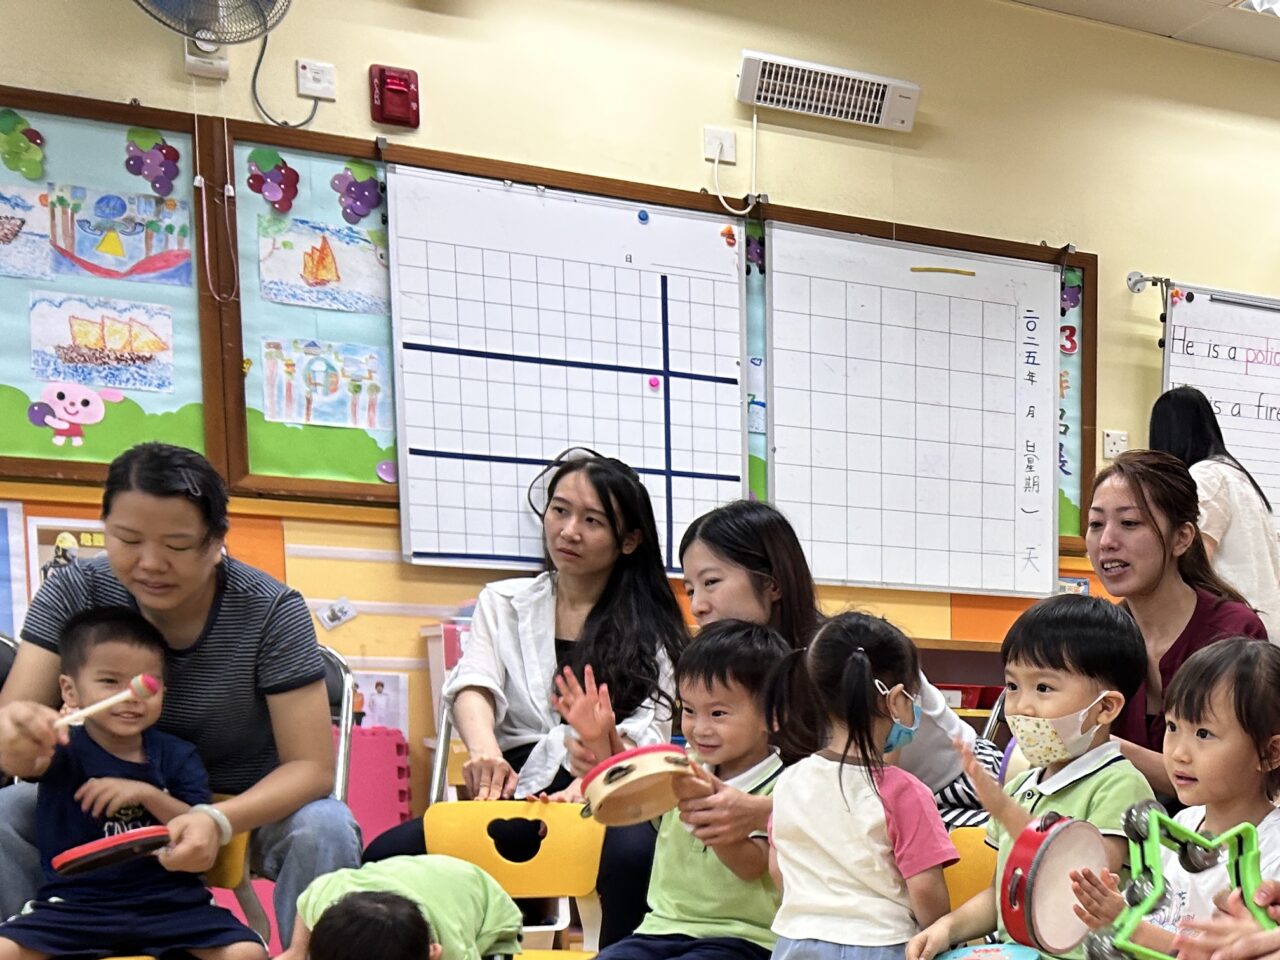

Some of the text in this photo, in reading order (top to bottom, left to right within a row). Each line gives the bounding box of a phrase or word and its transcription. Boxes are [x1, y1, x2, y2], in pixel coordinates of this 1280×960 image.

[1171, 324, 1195, 355] He
[1207, 339, 1220, 359] is
[1227, 346, 1238, 362] a
[1230, 402, 1242, 418] a
